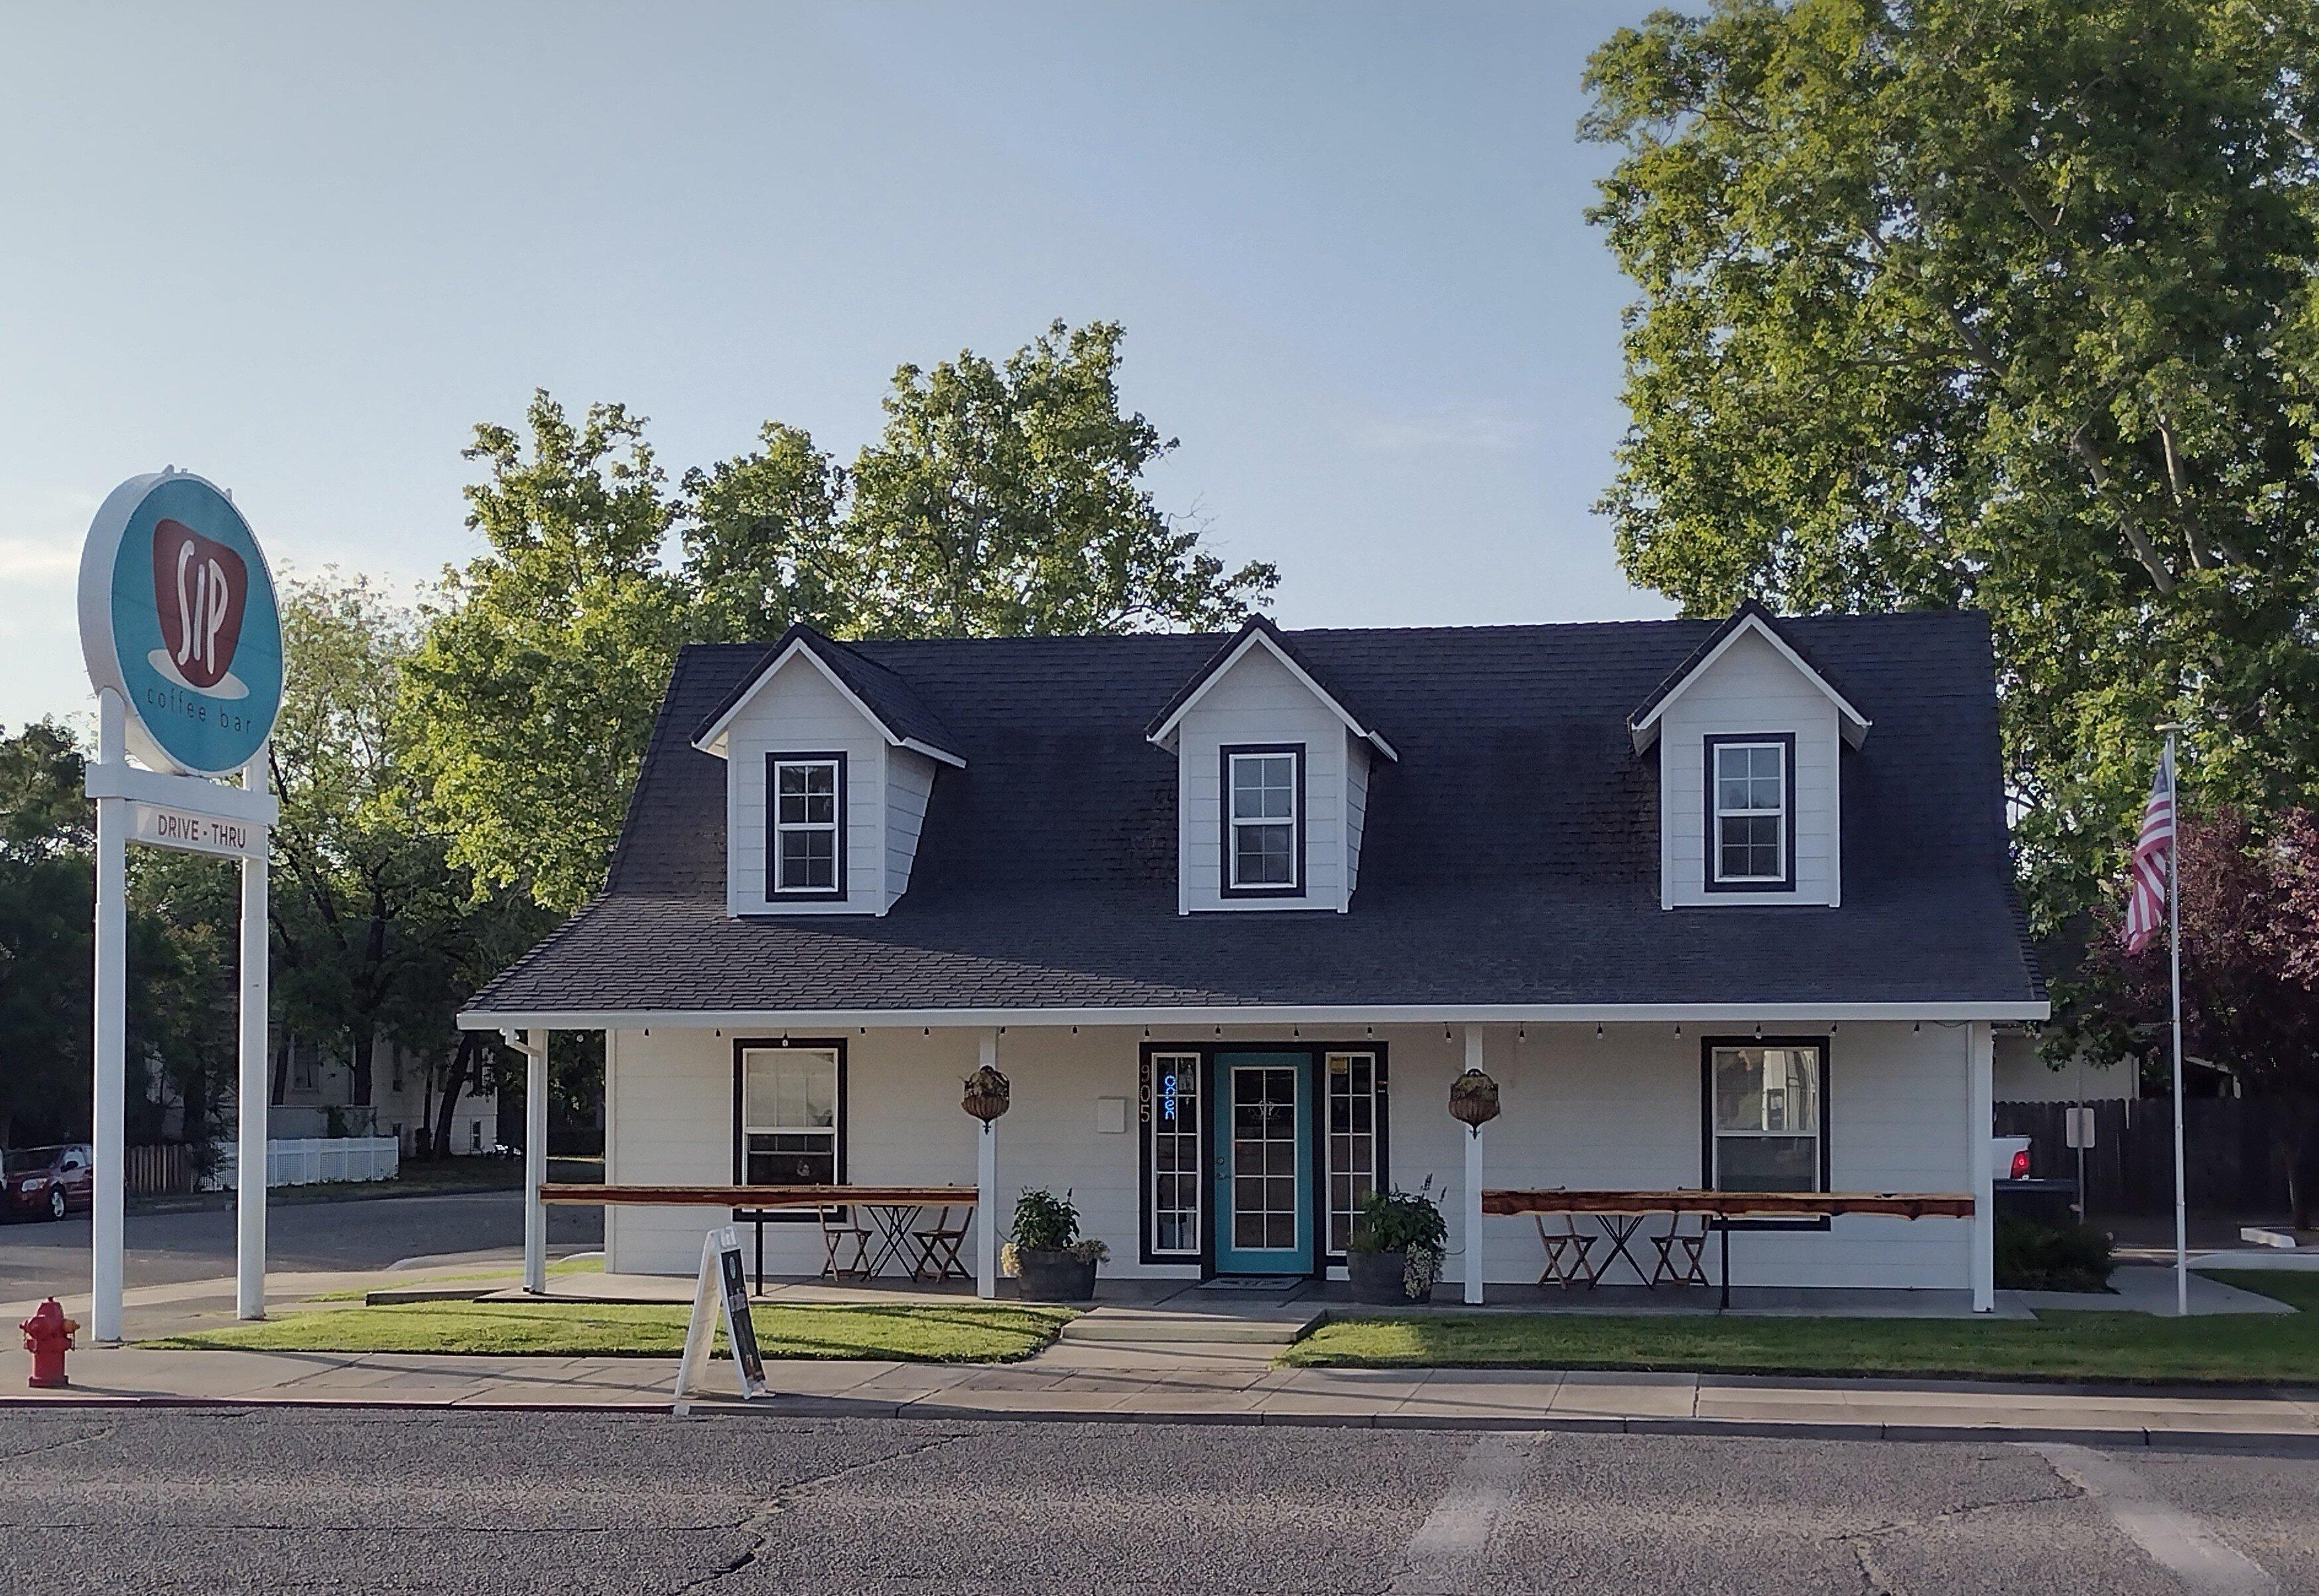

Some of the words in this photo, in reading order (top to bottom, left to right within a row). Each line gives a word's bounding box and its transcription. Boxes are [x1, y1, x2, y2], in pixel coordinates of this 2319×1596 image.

[177, 539, 228, 675] SIP
[147, 688, 206, 722] coffee
[220, 705, 251, 734] bar
[1140, 1064, 1151, 1122] 905
